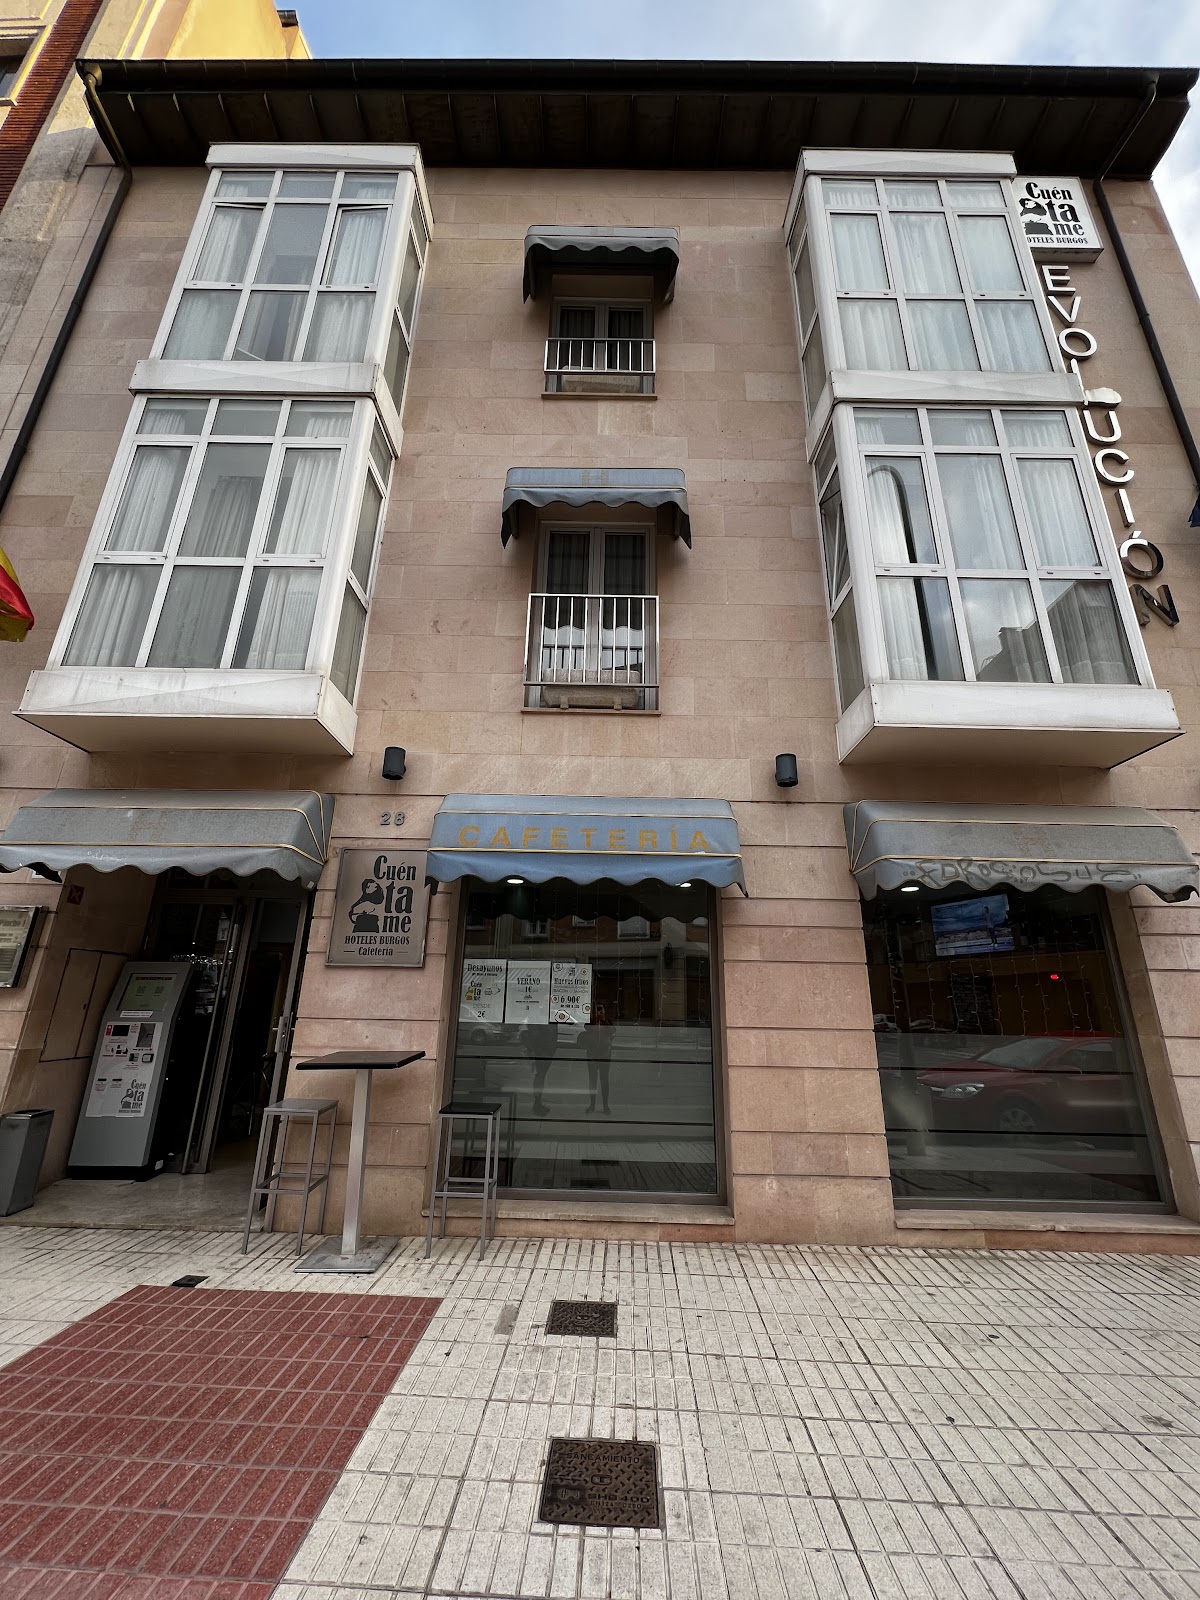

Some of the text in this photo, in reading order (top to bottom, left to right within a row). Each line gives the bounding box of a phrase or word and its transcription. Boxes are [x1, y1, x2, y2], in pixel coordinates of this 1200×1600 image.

[1025, 182, 1073, 200] Cuén
[1045, 199, 1081, 223] ta
[1052, 223, 1084, 236] me
[1026, 236, 1089, 245] OTELES BURGOS
[1041, 265, 1180, 627] EVOLUCIÓN
[380, 811, 405, 826] 28
[458, 824, 711, 851] CAFETERÍA
[373, 855, 417, 881] Cuén
[384, 881, 414, 914] ta
[381, 915, 412, 933] me
[344, 935, 410, 945] HOTELES BURGOS
[358, 946, 394, 956] Cafetería
[467, 963, 503, 973] Desayunos
[517, 977, 541, 986] VERANO
[566, 1452, 640, 1465] SANEAMIENTO
[620, 1495, 650, 1503] 400
